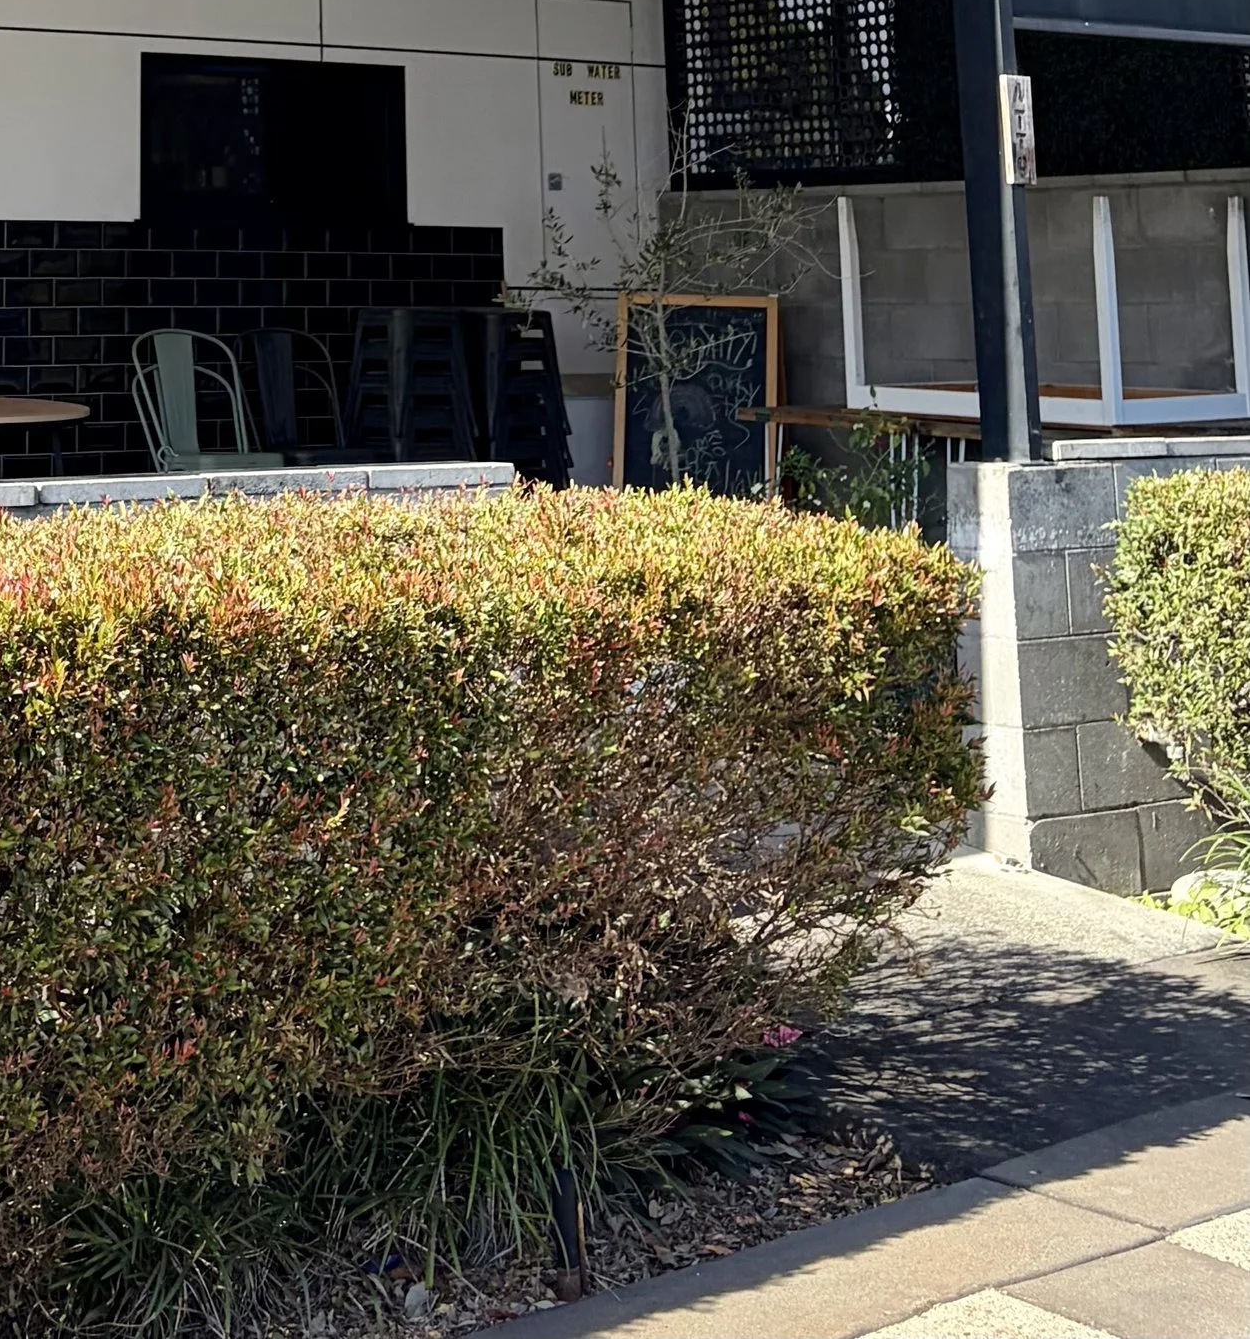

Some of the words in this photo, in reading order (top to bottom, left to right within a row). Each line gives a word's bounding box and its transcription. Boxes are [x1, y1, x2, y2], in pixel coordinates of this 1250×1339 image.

[553, 62, 573, 77] SUB
[587, 64, 621, 79] WATER
[569, 90, 604, 106] METER
